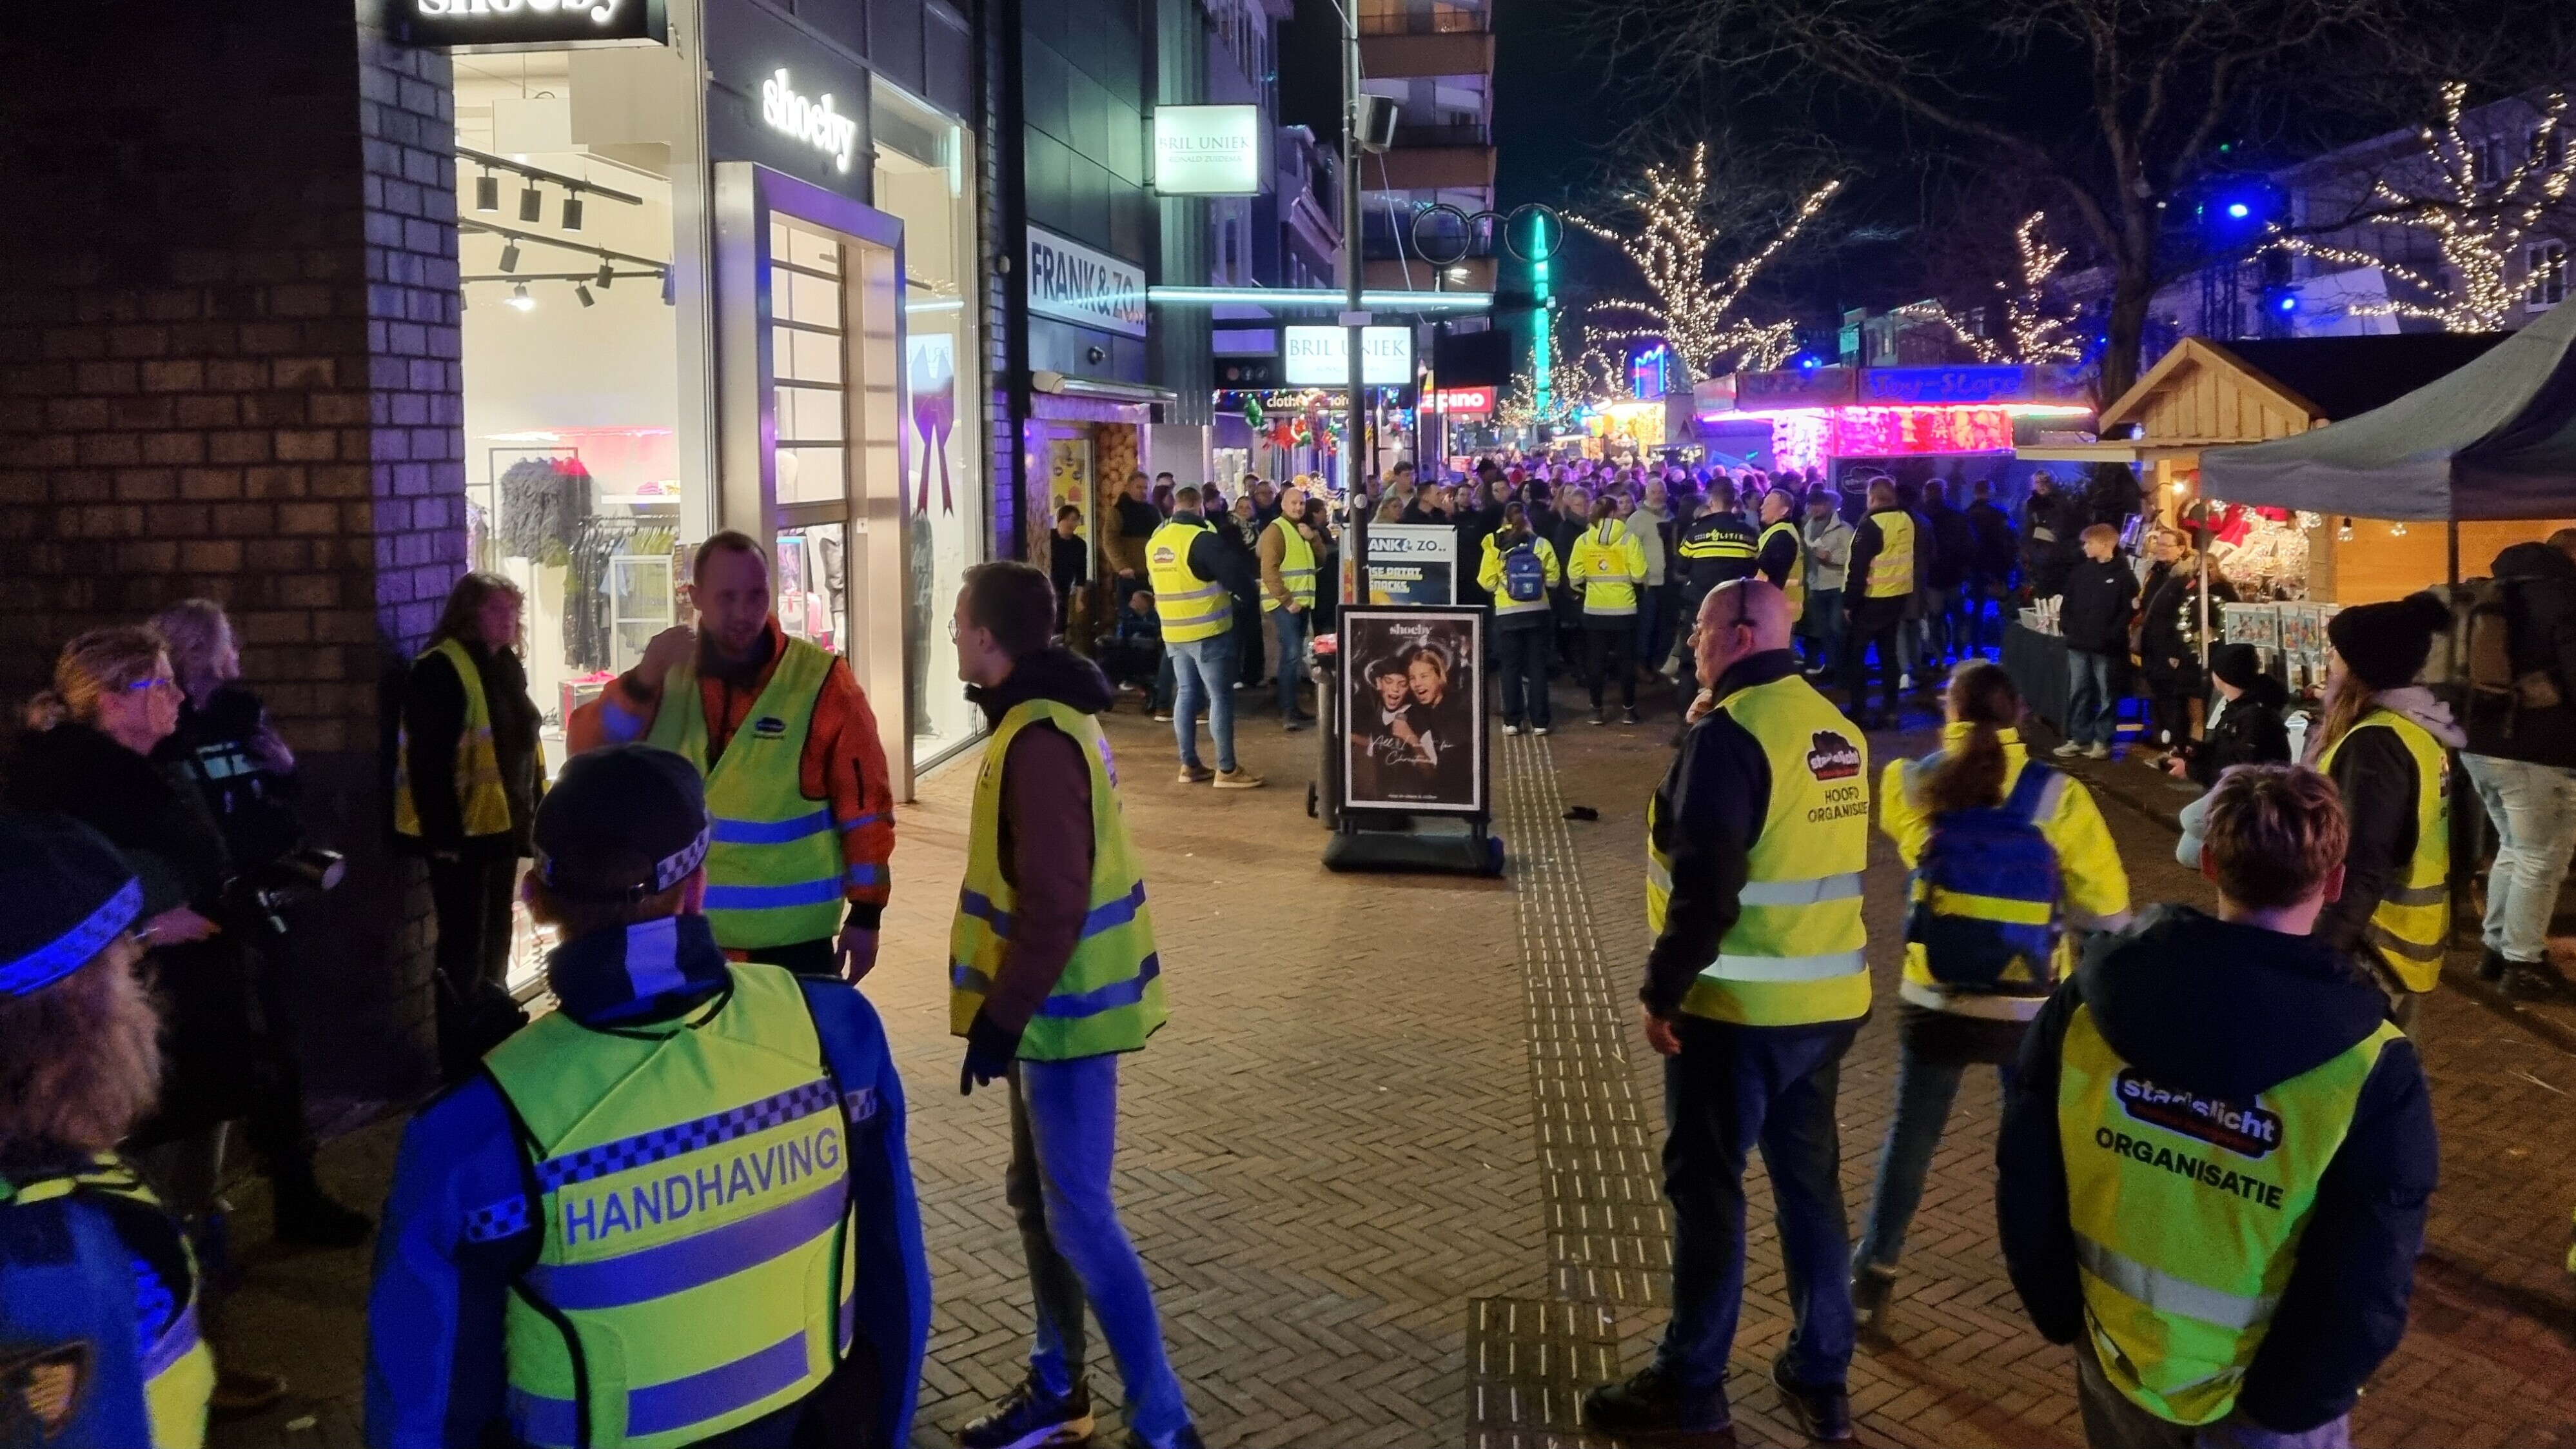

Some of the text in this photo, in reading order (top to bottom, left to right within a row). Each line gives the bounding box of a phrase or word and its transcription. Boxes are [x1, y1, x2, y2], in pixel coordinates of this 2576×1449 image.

[763, 68, 856, 171] shoeby
[1159, 136, 1250, 149] BRIL UNIEK
[1032, 241, 1096, 313] FRANK
[1097, 265, 1110, 316] &
[1290, 339, 1333, 355] BRIL
[1421, 393, 1485, 413] apino
[565, 1127, 840, 1245] HANDHAVING
[2096, 1127, 2284, 1210] ORGANISATIE
